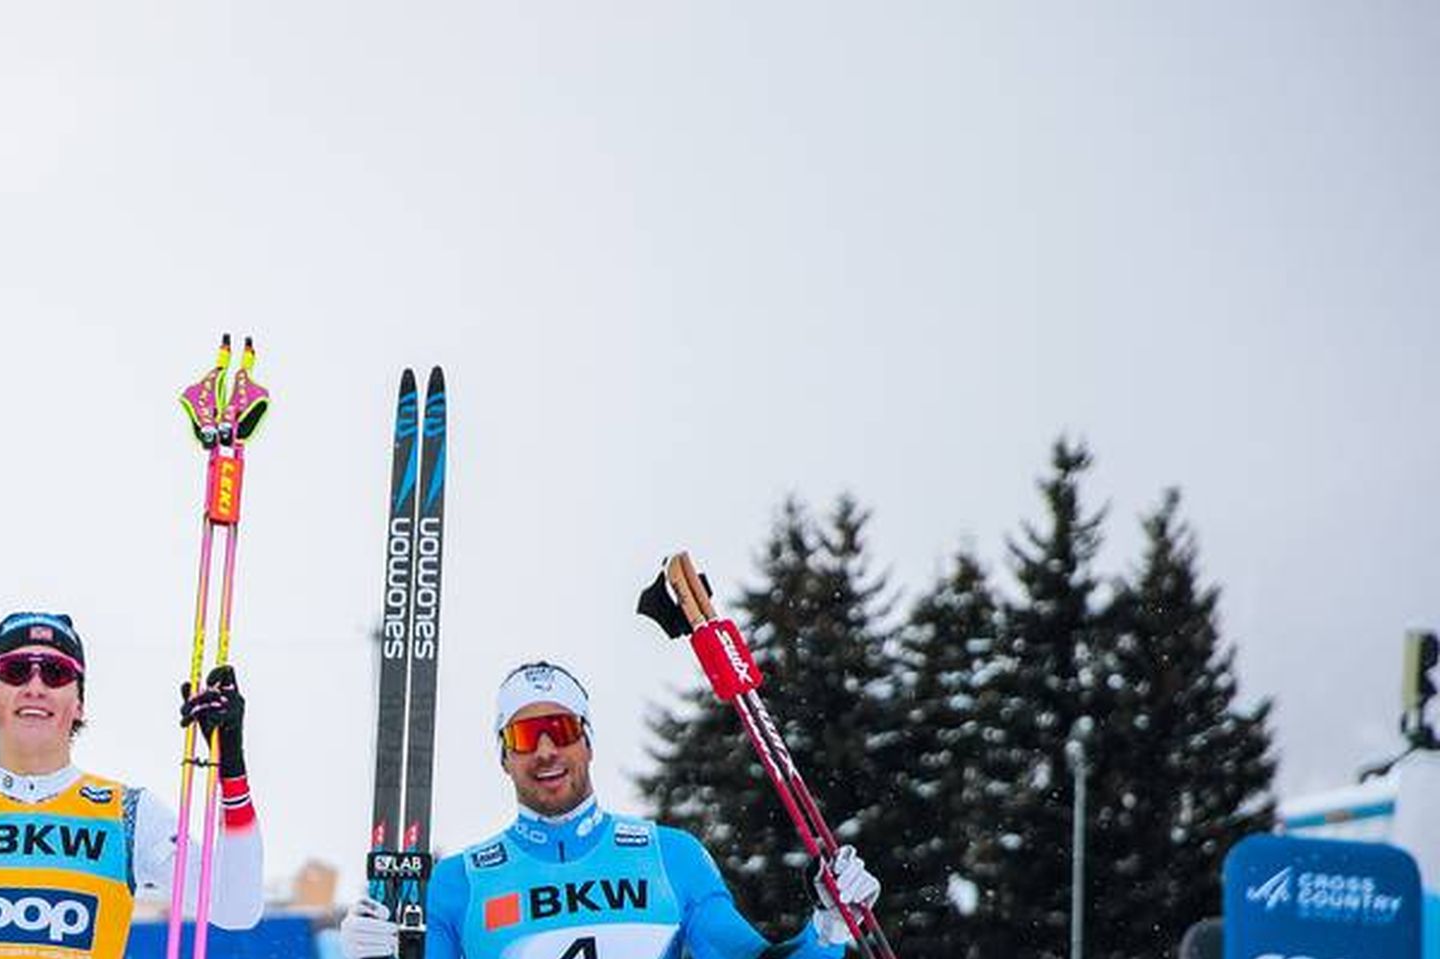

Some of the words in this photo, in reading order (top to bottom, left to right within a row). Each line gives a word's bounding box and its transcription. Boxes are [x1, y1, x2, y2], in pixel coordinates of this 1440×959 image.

[384, 517, 410, 659] salomon
[414, 517, 440, 659] salomon
[529, 879, 649, 921] BKW
[1298, 872, 1375, 893] CROSS
